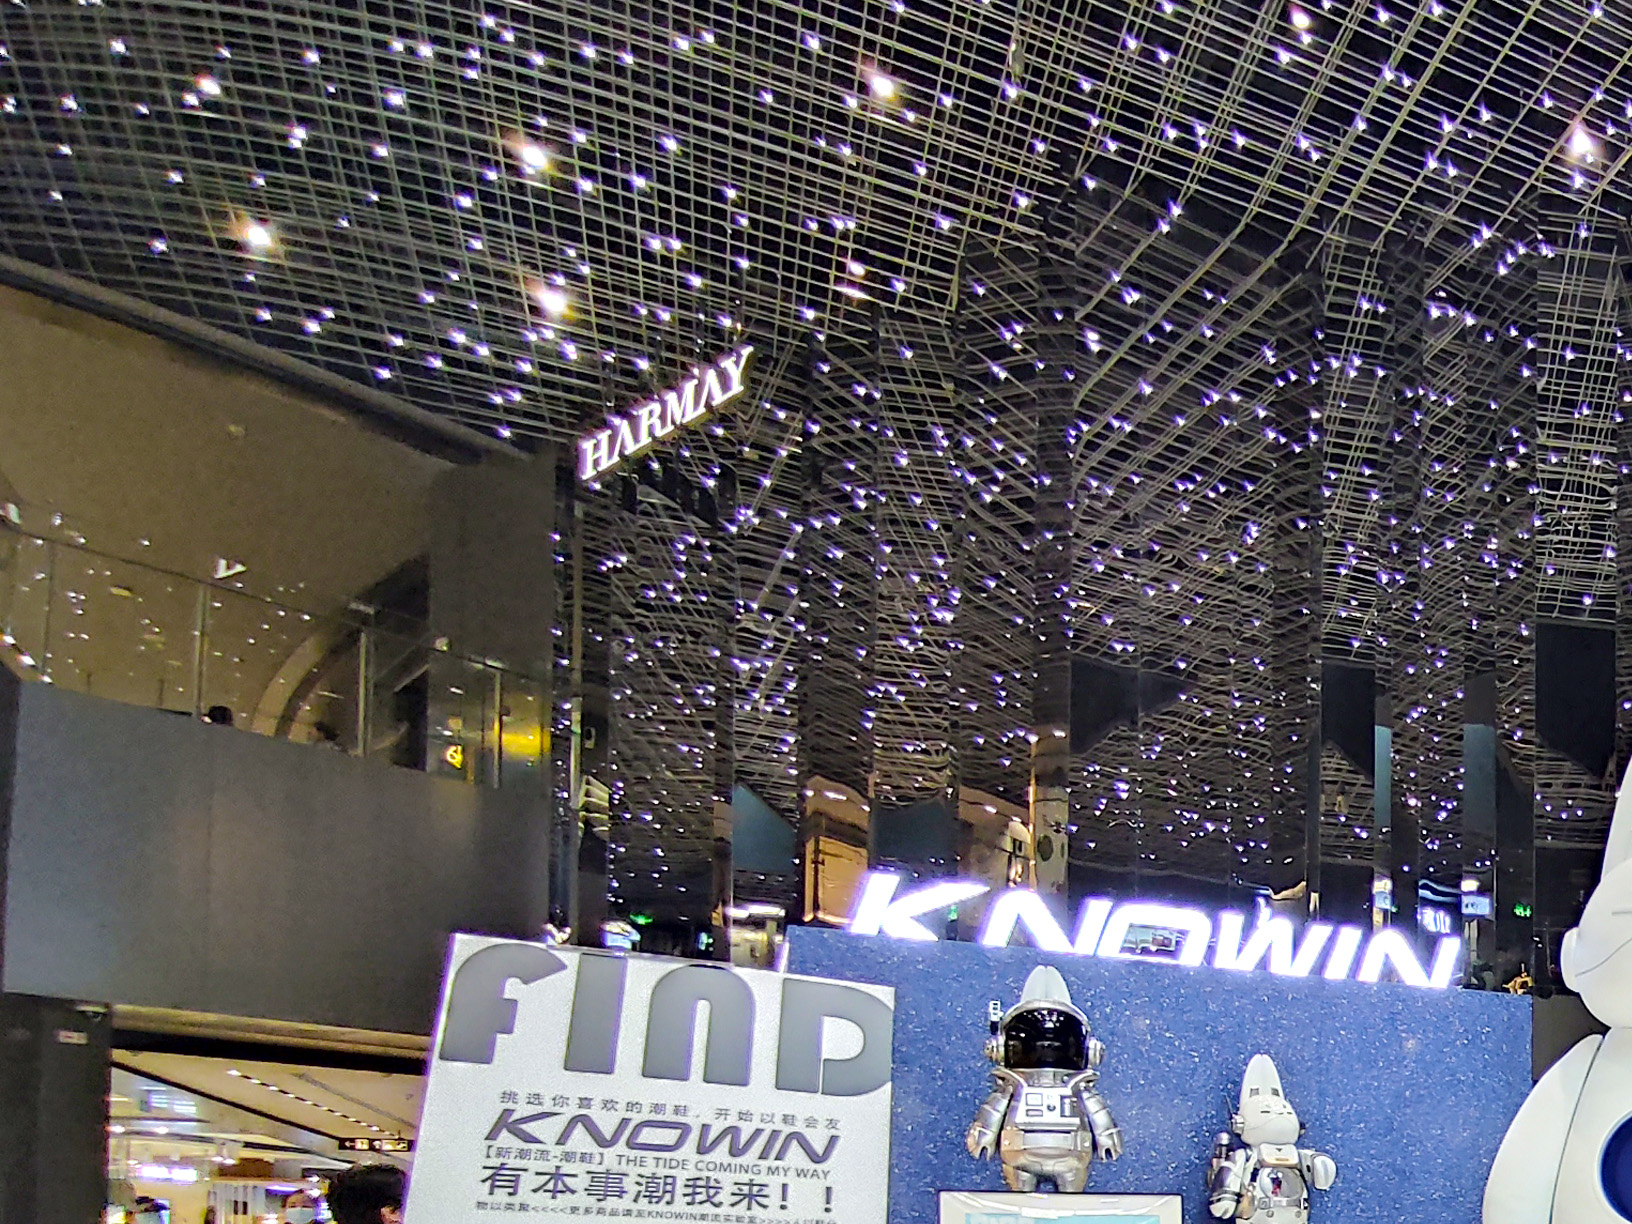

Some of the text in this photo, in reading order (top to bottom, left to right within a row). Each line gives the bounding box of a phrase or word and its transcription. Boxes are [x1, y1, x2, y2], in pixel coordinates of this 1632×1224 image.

[581, 345, 755, 480] HARMAY
[850, 871, 1462, 989] KNOWIN
[438, 942, 894, 1096] FIND
[483, 1108, 842, 1165] KNOWIN
[615, 1154, 648, 1168] THE
[653, 1157, 690, 1171] TIDE
[694, 1160, 762, 1176] COMING
[766, 1166, 792, 1178] MY
[795, 1168, 831, 1181] WAY
